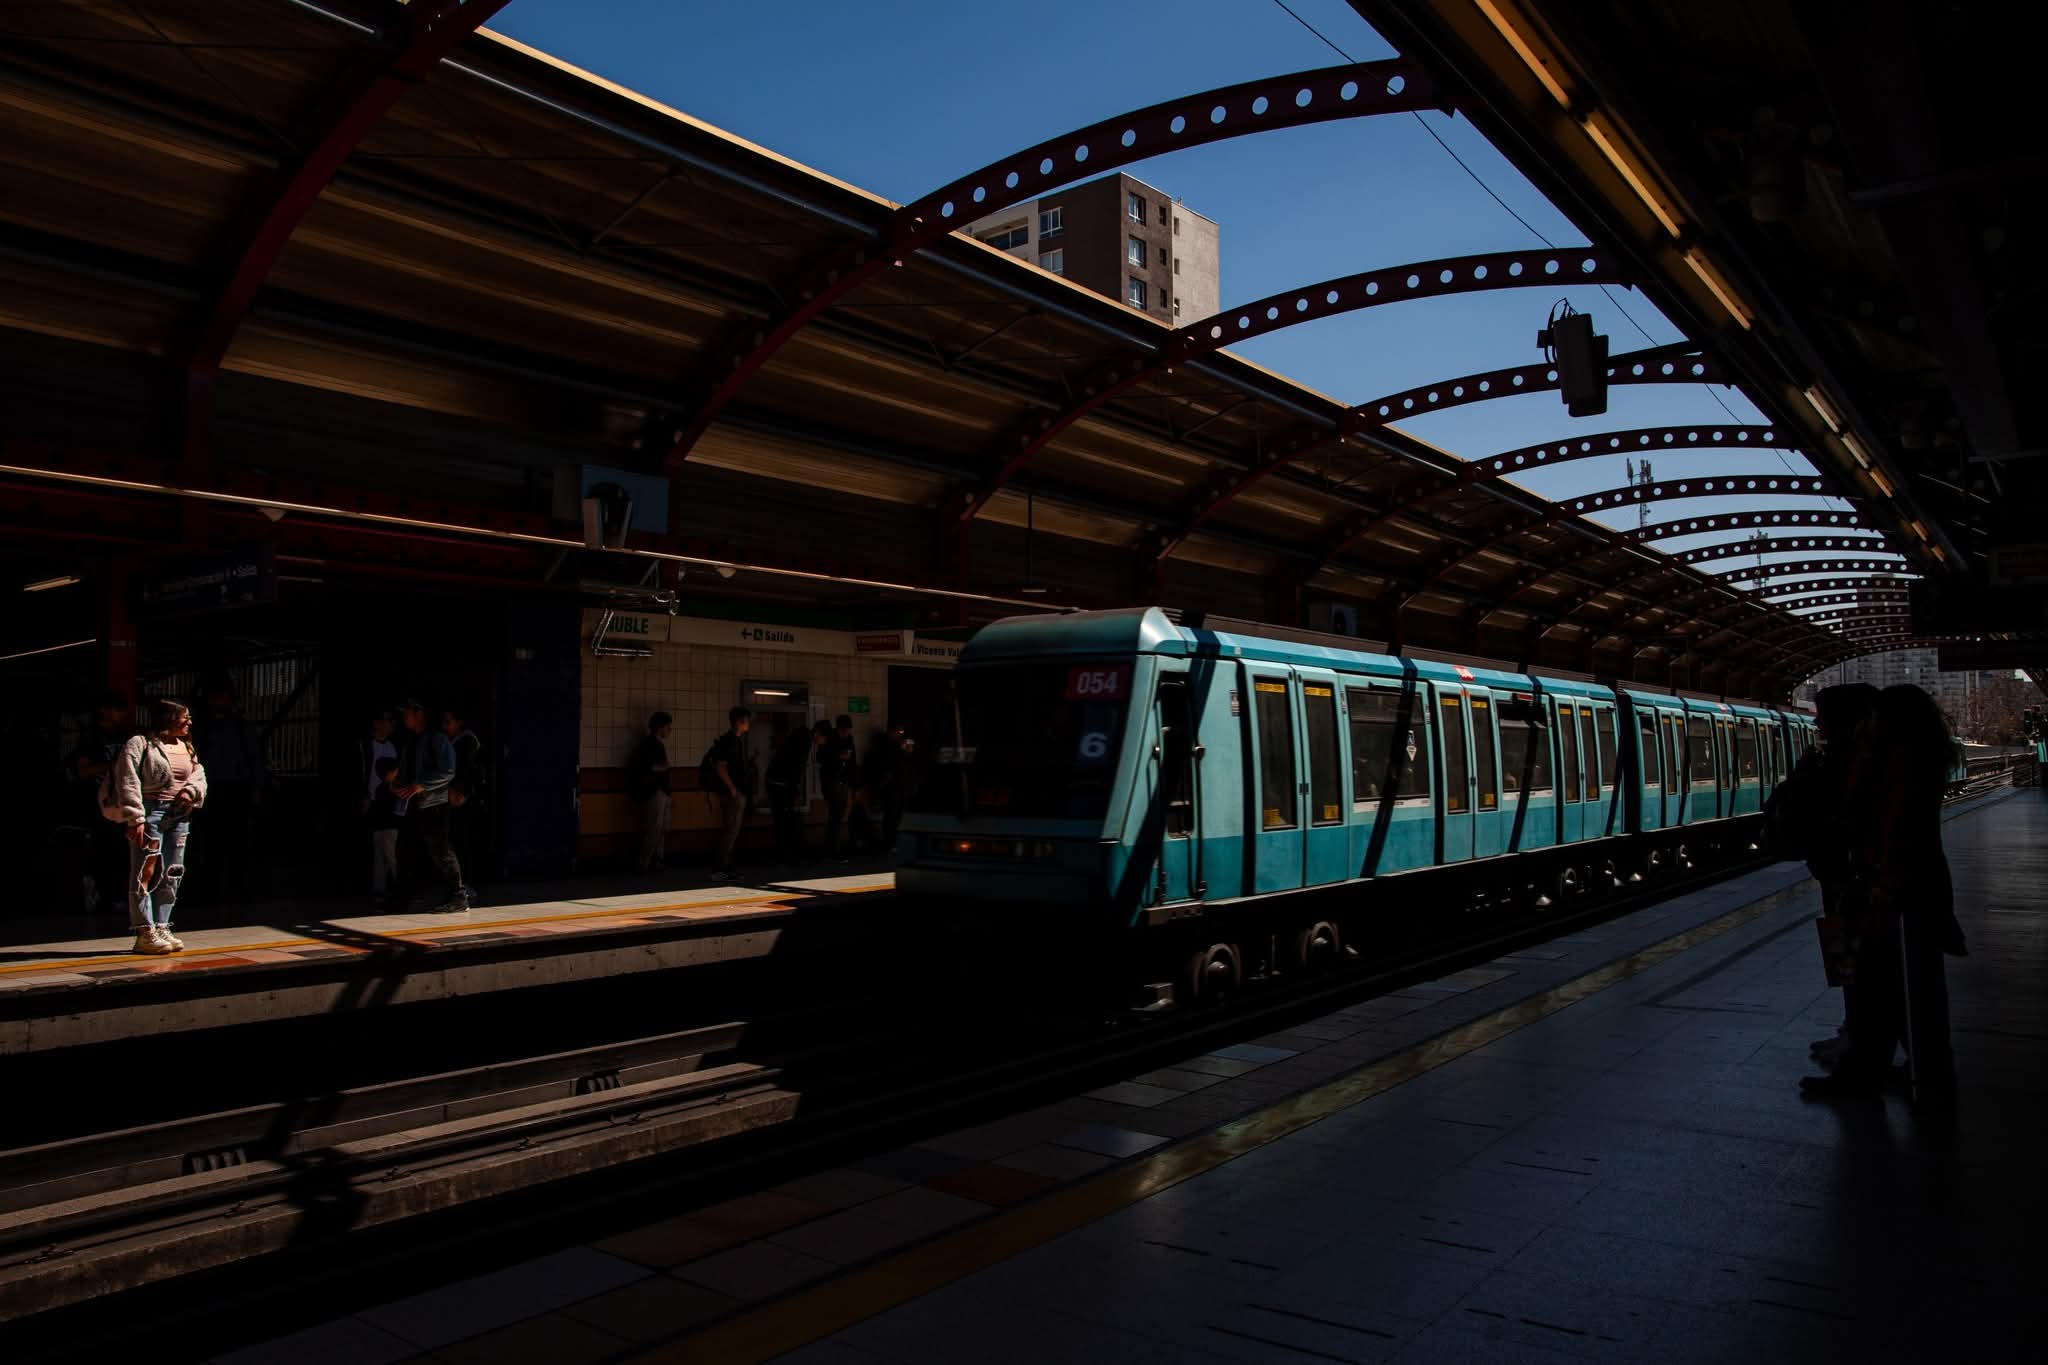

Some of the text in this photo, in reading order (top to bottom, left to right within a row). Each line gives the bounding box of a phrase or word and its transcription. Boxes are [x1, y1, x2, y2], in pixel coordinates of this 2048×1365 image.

[765, 631, 794, 643] Salida
[1077, 671, 1119, 696] 054
[1079, 731, 1108, 759] 6
